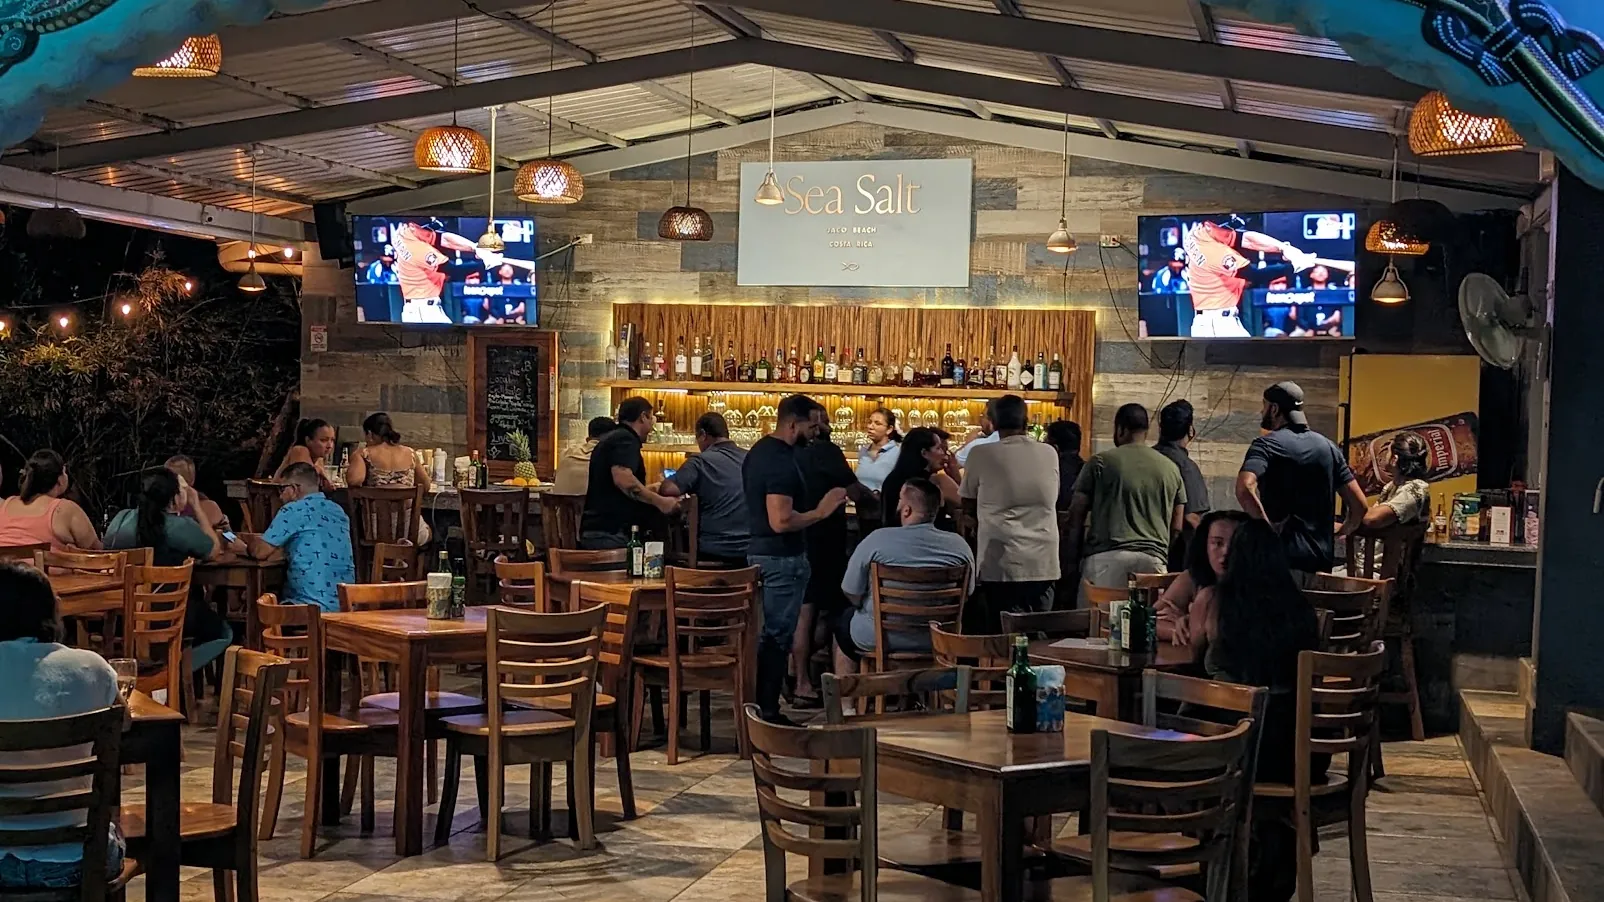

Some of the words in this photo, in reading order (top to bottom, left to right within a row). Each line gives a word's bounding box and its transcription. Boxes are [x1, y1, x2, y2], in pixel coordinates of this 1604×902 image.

[785, 175, 844, 215] Sea
[854, 173, 921, 215] Salt
[852, 226, 877, 234] BEACH
[1427, 429, 1450, 472] Imperial
